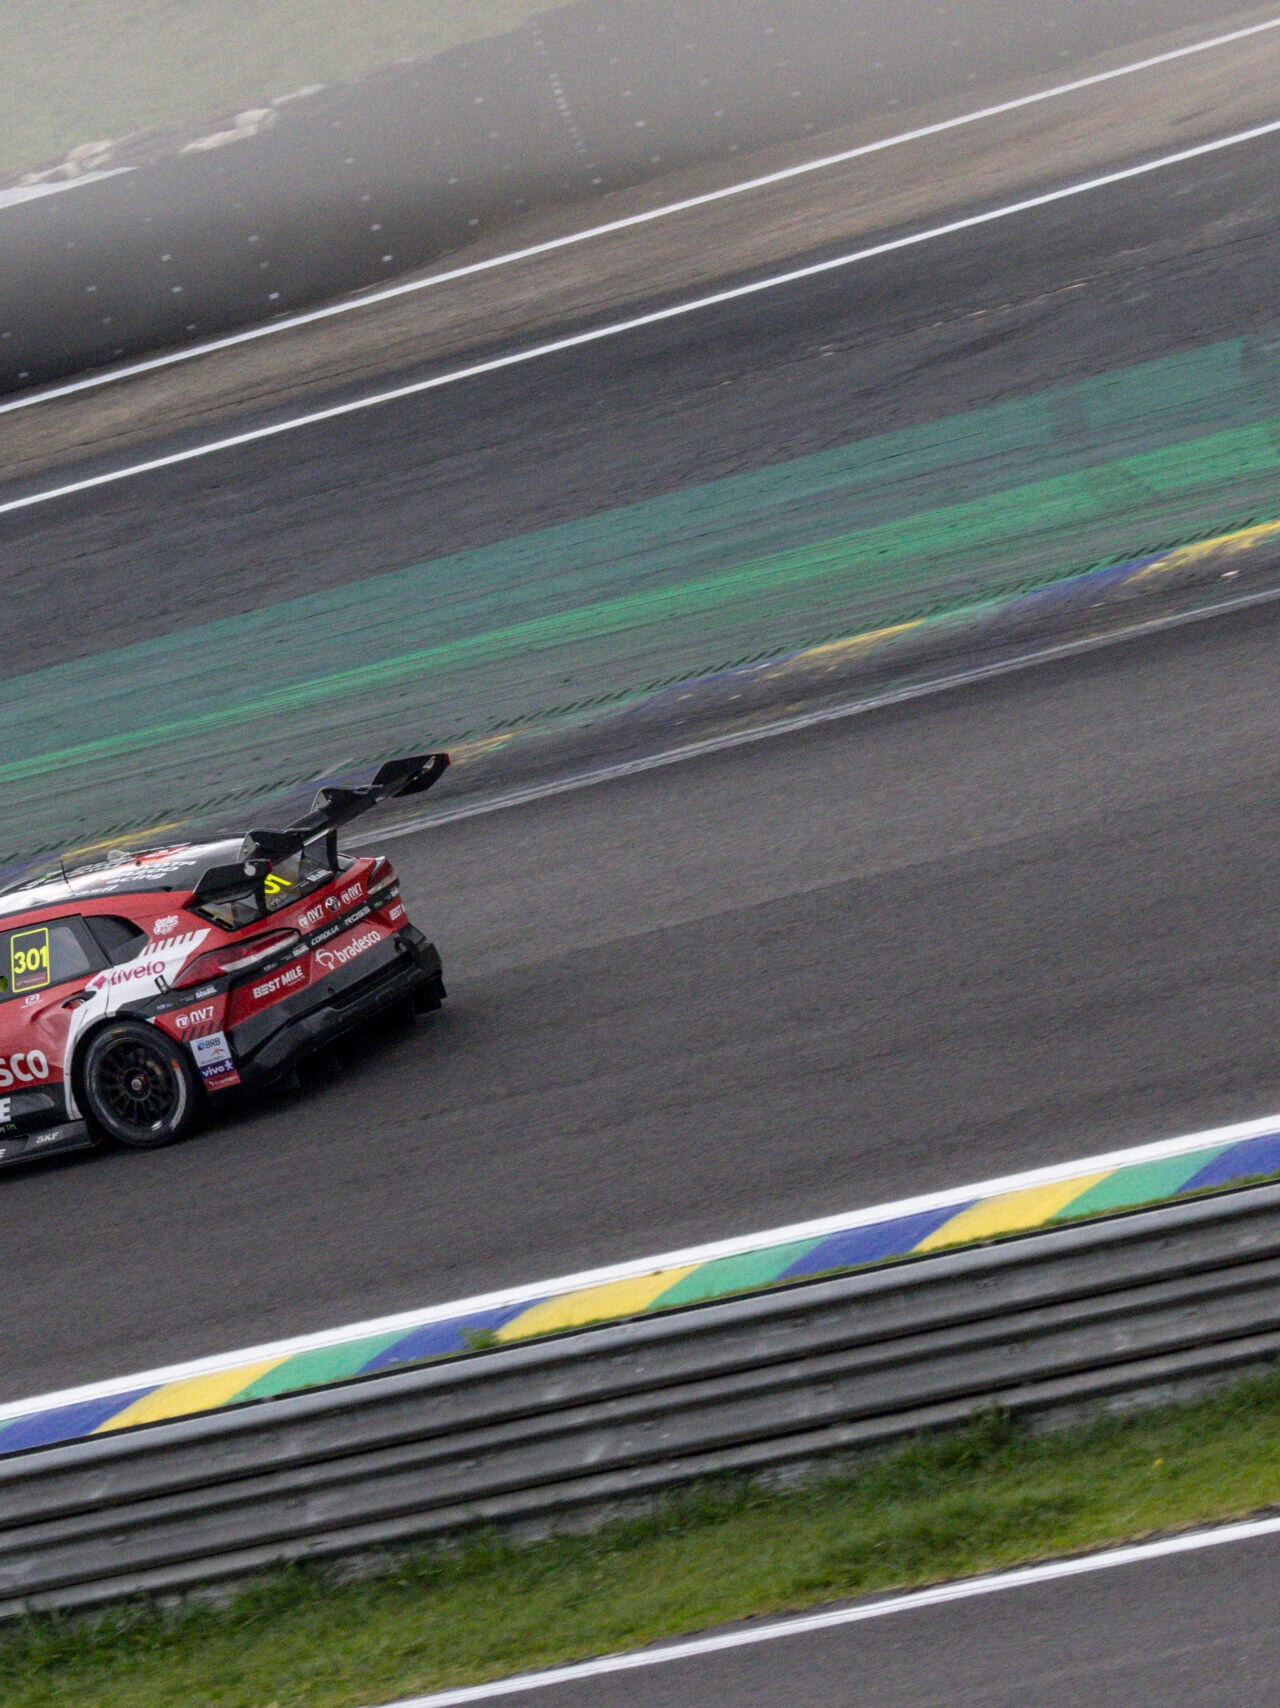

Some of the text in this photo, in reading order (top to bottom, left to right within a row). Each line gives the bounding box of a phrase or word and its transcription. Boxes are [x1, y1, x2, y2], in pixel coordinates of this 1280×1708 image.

[311, 925, 339, 946] COROLLA
[335, 930, 381, 963] bradesco
[13, 945, 49, 975] 301
[253, 978, 281, 999] BEST
[281, 965, 304, 985] MILE
[205, 1037, 221, 1050] BRB
[202, 1066, 224, 1078] vivo
[36, 1131, 60, 1144] SKF
